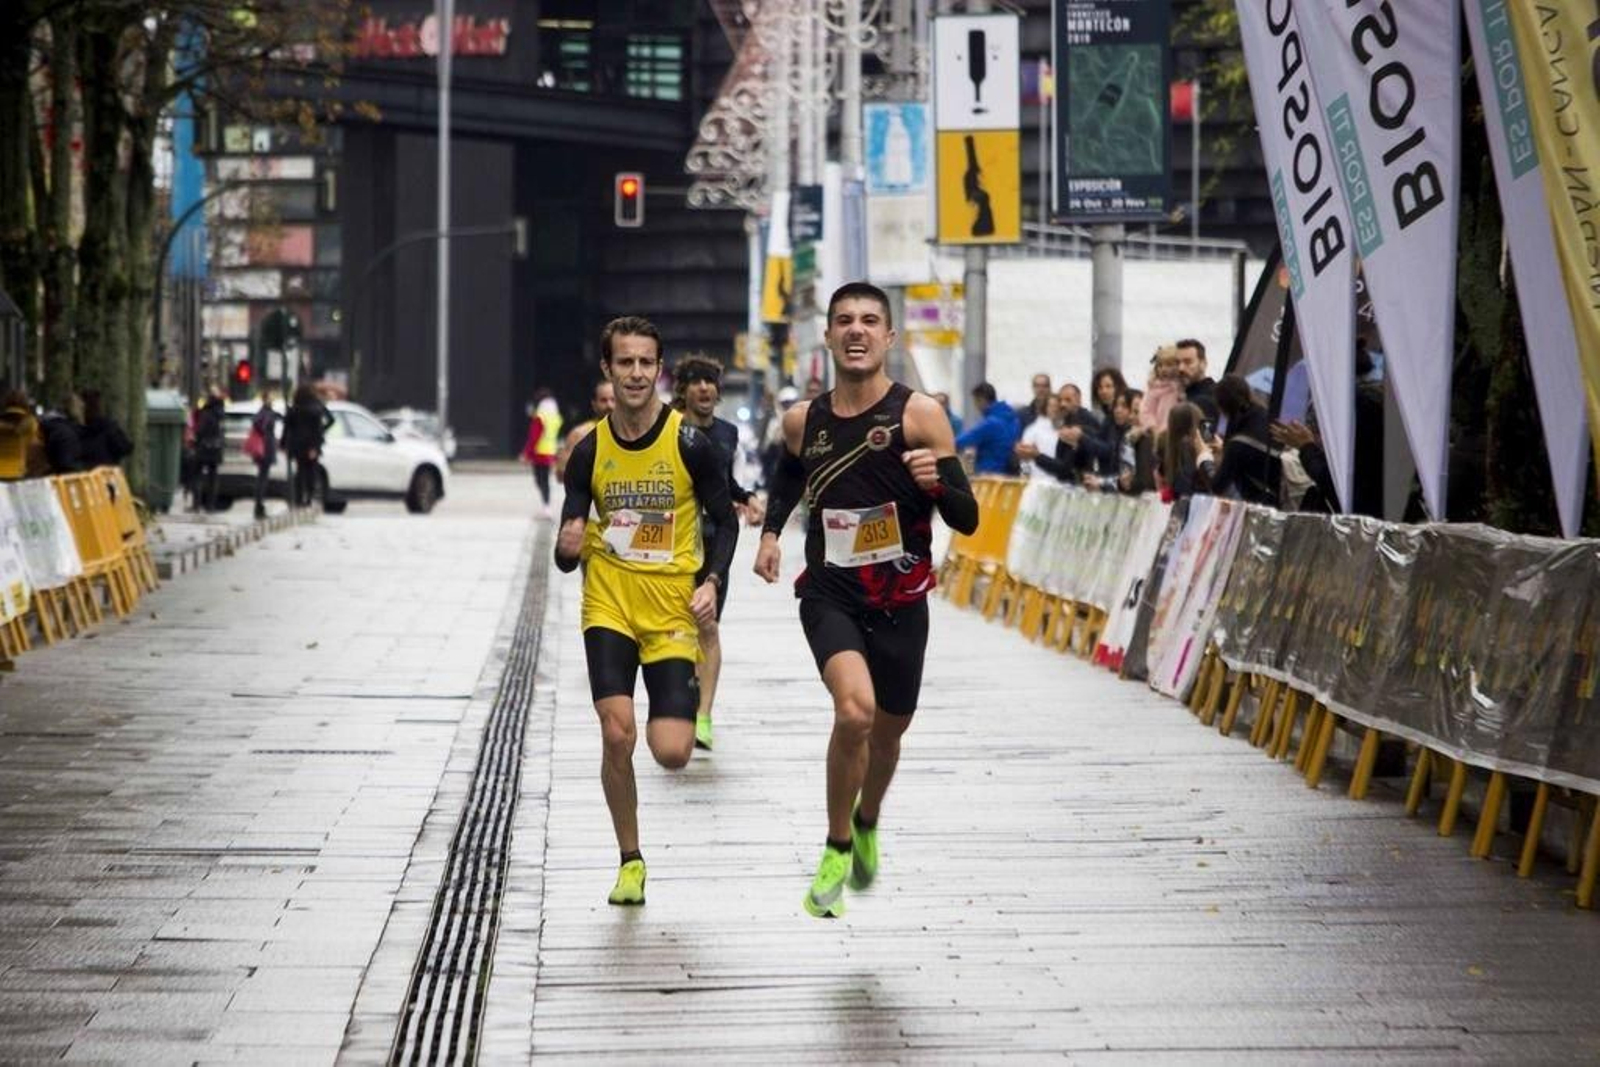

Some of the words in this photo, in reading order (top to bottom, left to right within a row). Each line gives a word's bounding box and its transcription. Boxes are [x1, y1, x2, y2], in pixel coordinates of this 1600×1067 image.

[604, 481, 674, 496] ATHLETICS
[641, 525, 663, 543] 521
[862, 520, 889, 543] 313
